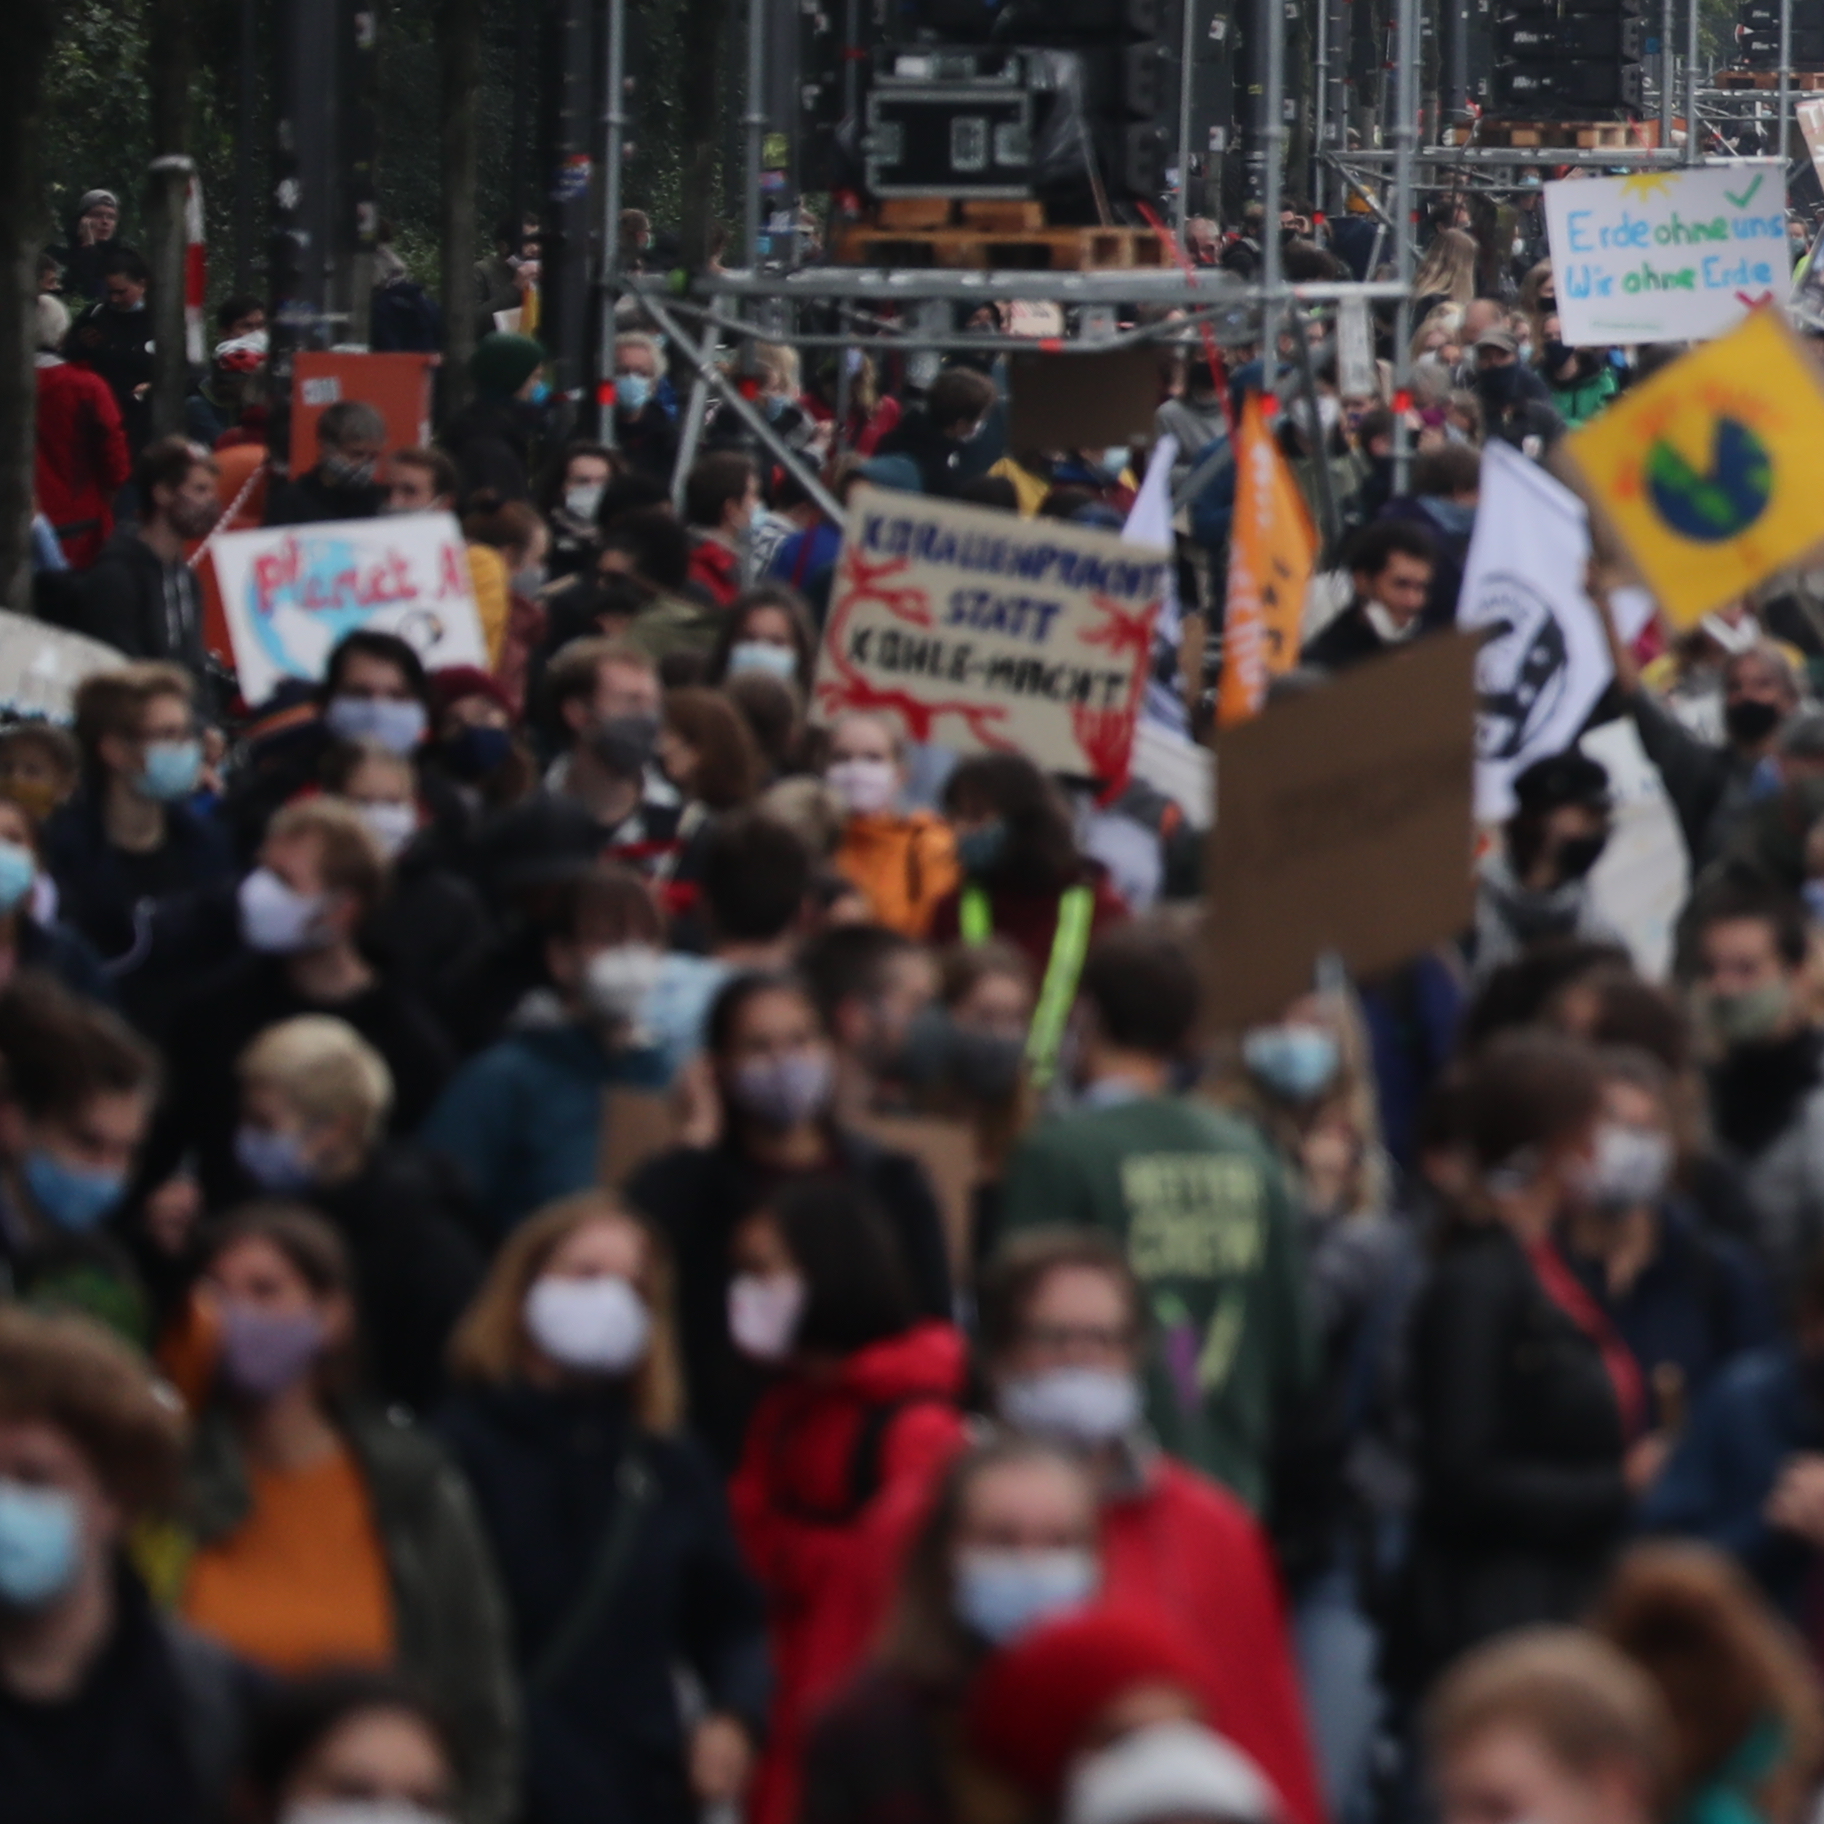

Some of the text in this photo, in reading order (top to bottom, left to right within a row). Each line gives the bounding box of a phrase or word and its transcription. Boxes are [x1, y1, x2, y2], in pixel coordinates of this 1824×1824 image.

[1566, 209, 1785, 253] Erde ohne uns
[1565, 255, 1774, 299] Wir ohne Erde
[945, 587, 1064, 645] STATT
[849, 626, 1129, 709] KOHLE-MACHT
